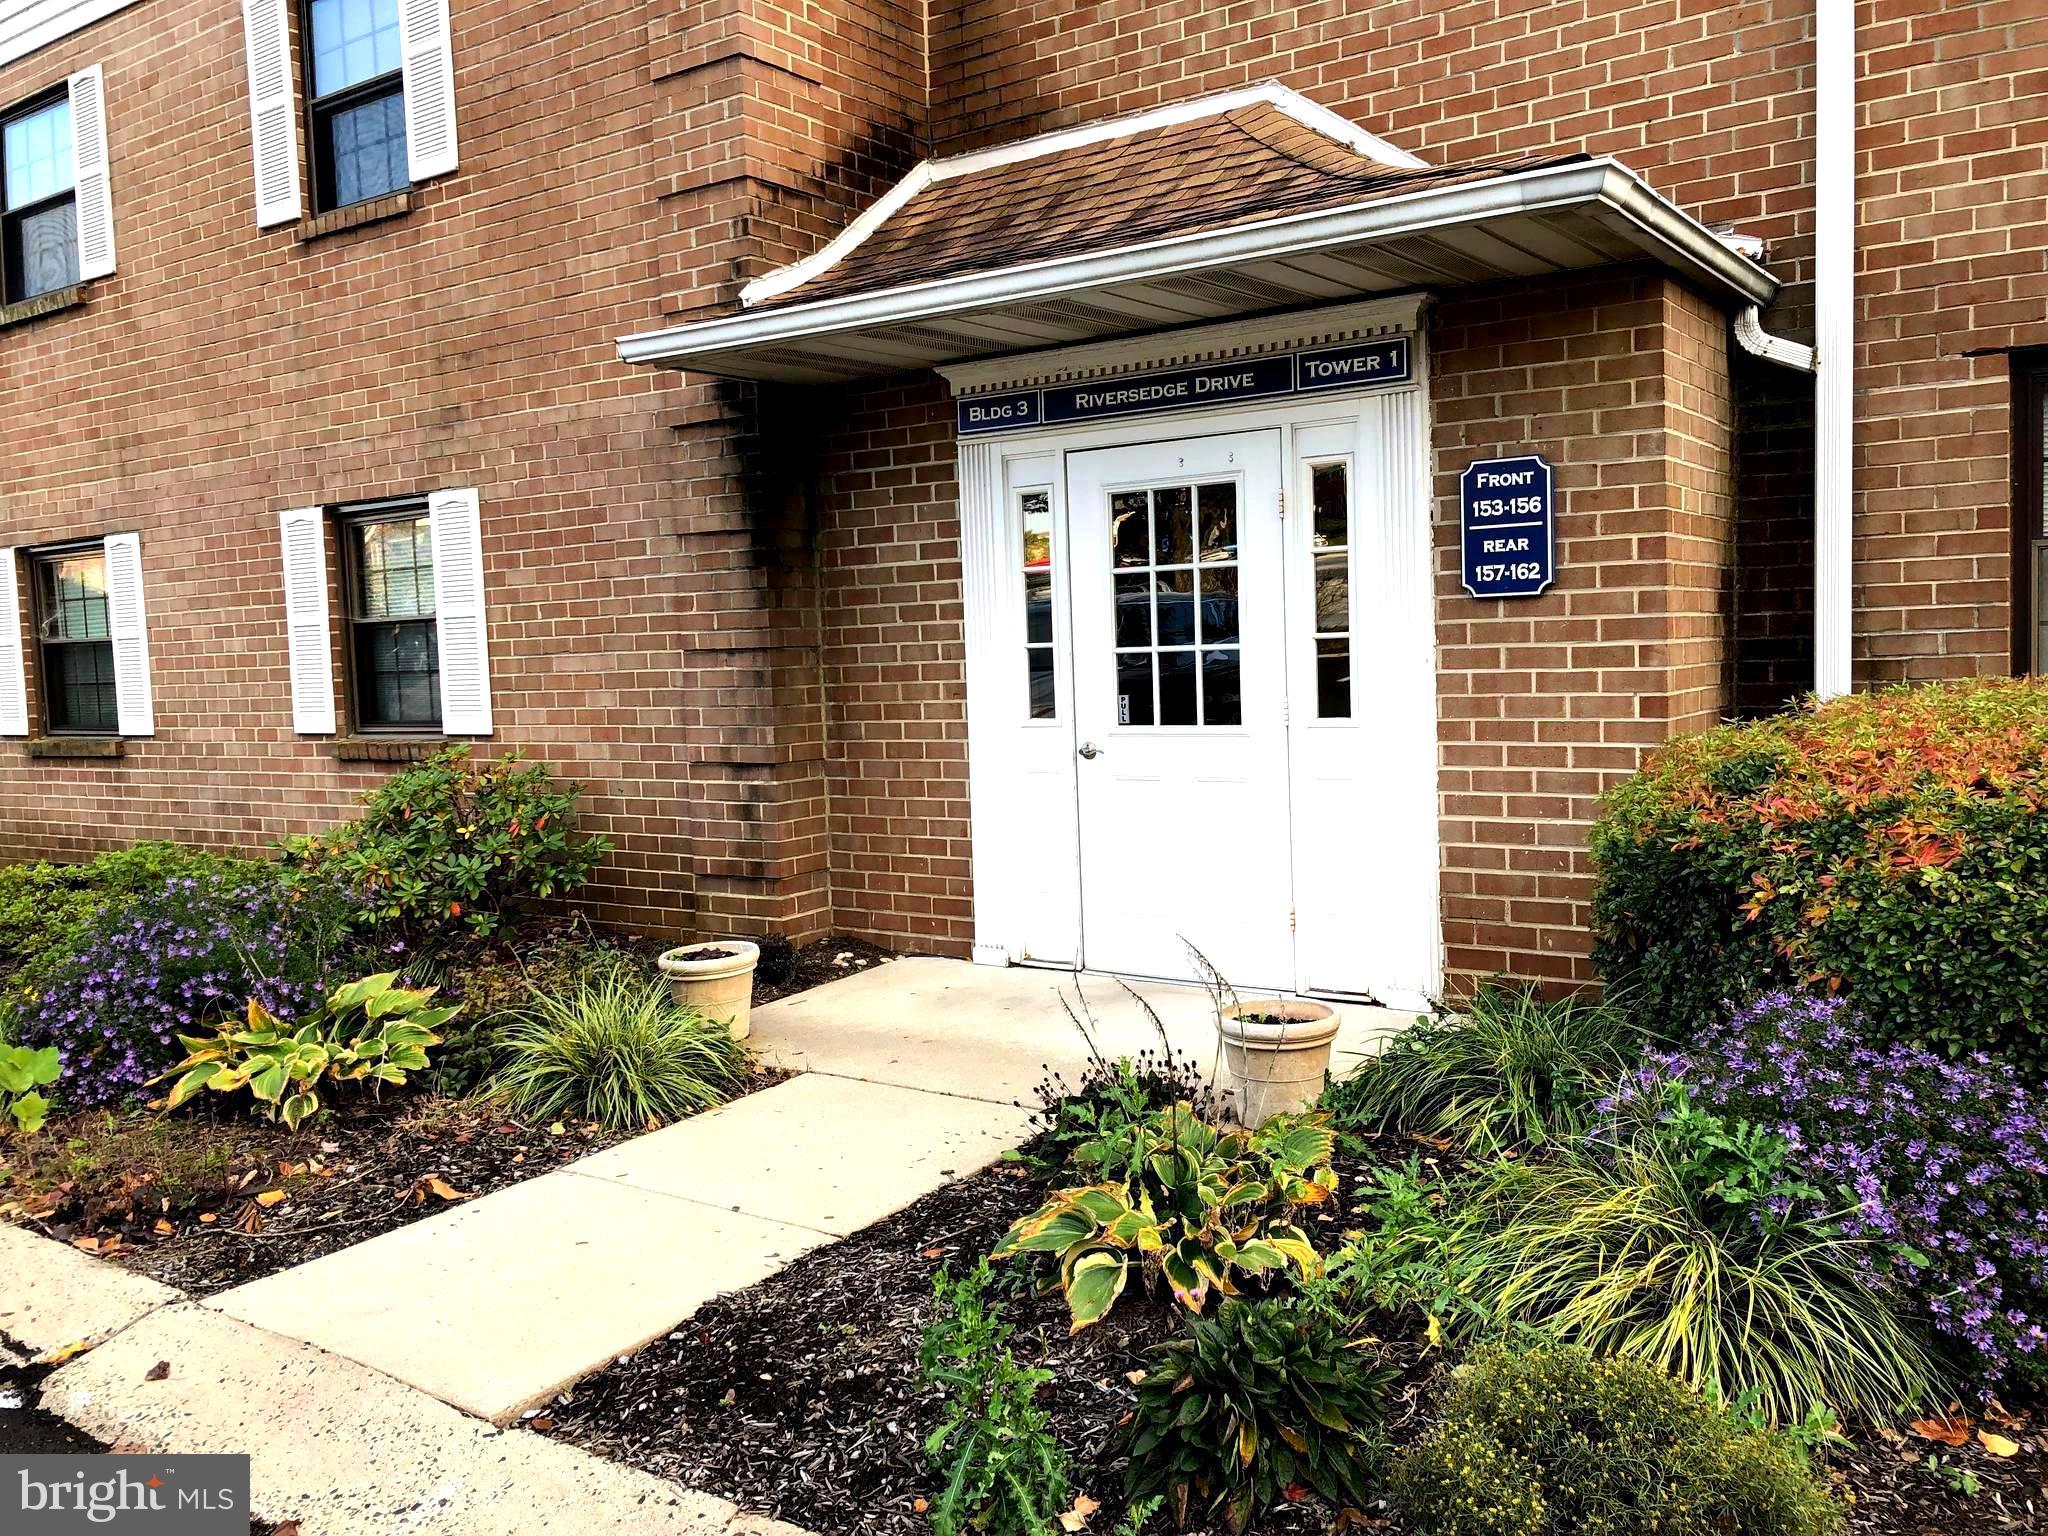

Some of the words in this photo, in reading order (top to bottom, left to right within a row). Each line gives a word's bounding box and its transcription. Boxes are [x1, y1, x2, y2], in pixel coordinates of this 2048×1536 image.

[1305, 355, 1381, 379] TOWER
[1390, 350, 1398, 368] 1
[1075, 381, 1188, 410] RIVERSEDGE
[1195, 372, 1255, 394] DRIVE
[969, 406, 1012, 423] BLDG
[1015, 401, 1028, 417] 3
[1477, 471, 1535, 488] FRONT
[1472, 496, 1542, 518] 153-156
[1483, 538, 1529, 553] REAR
[1475, 562, 1541, 582] 157-162
